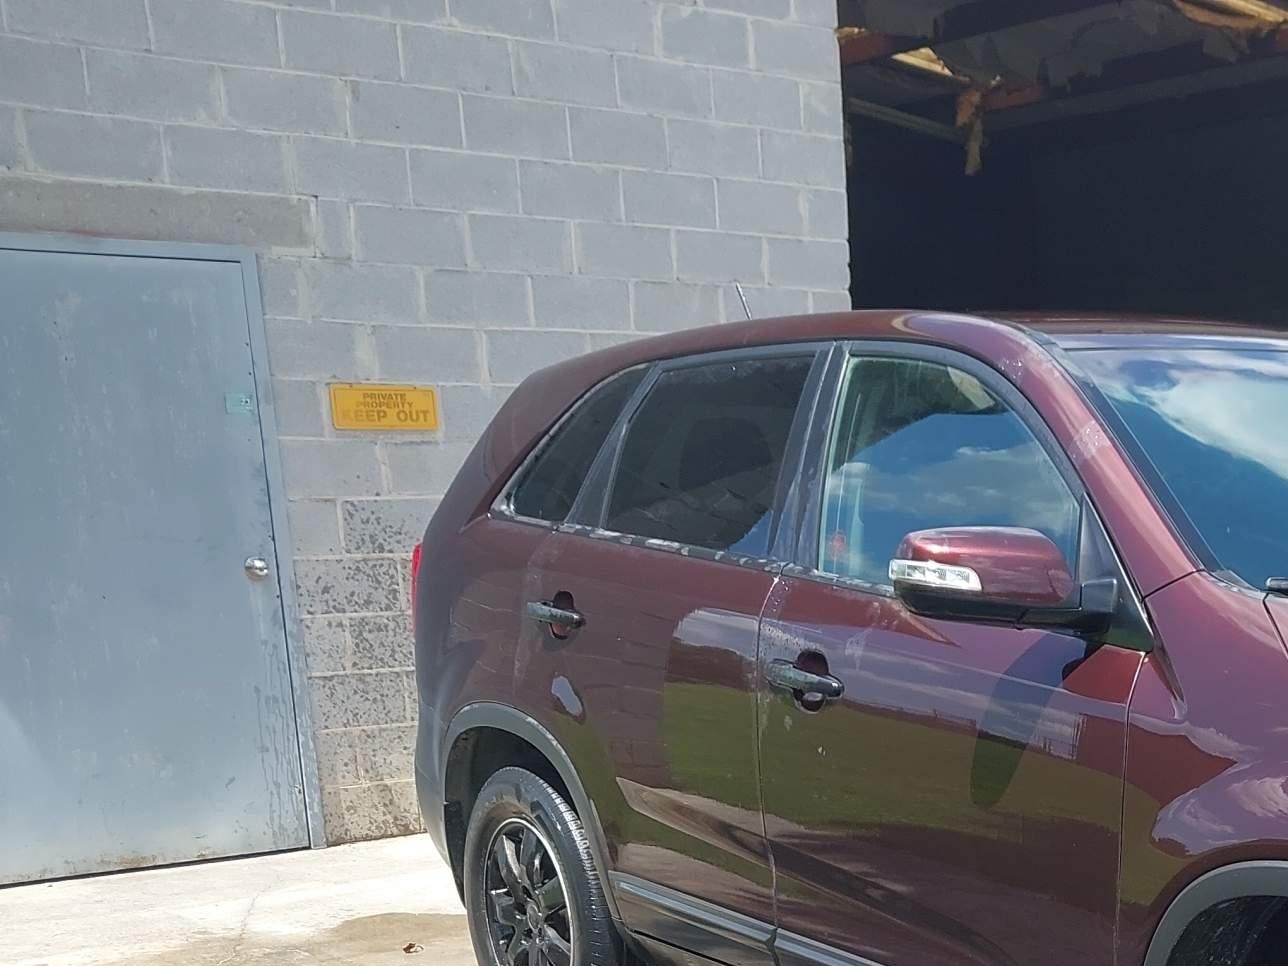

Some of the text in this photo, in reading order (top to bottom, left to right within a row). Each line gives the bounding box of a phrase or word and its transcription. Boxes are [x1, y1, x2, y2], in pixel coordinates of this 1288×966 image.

[362, 392, 407, 401] PRIVATE
[355, 400, 414, 409] PROPERTY
[396, 409, 431, 423] OUT
